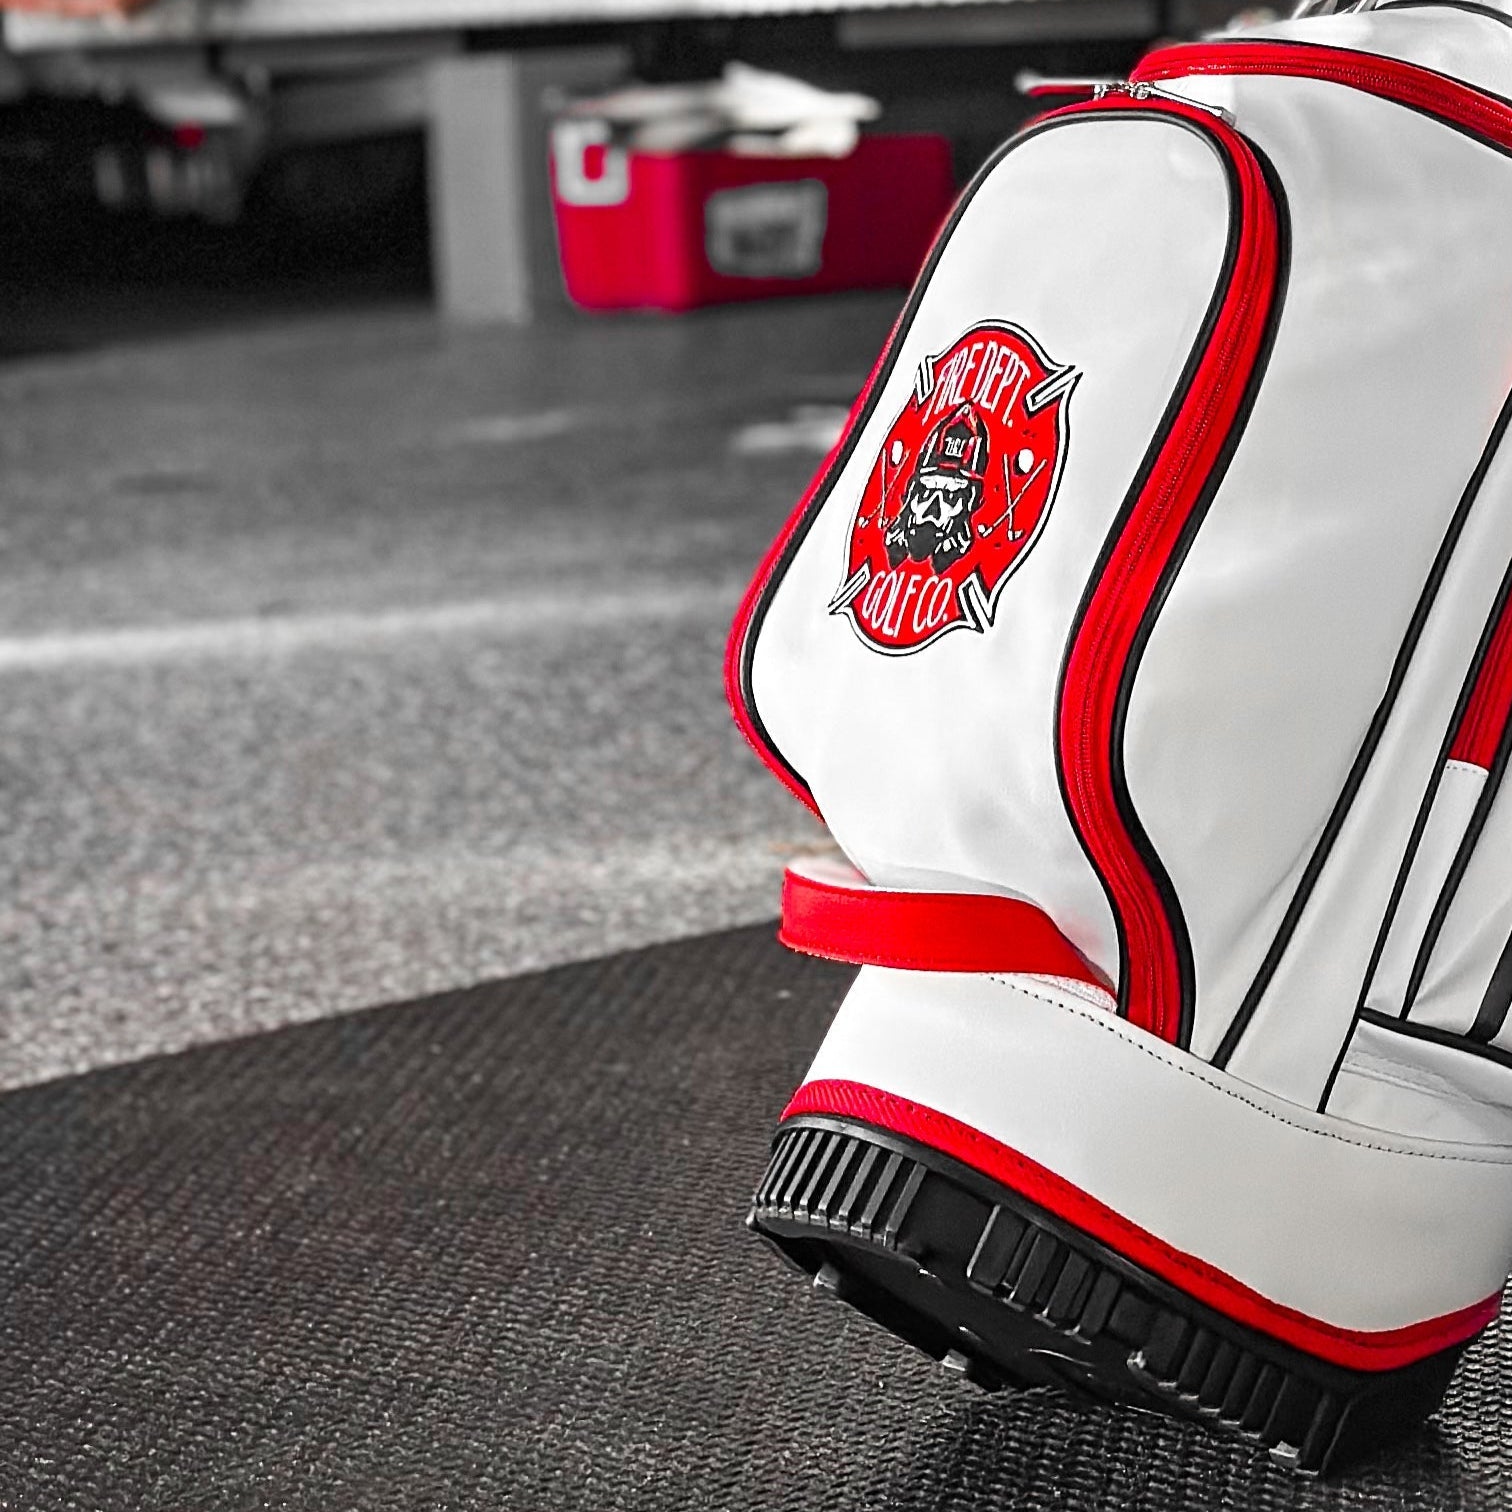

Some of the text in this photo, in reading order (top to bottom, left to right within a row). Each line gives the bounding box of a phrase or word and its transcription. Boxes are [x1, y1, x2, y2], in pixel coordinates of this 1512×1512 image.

[921, 341, 984, 426] FIRE
[862, 570, 948, 637] GOLF CO.
